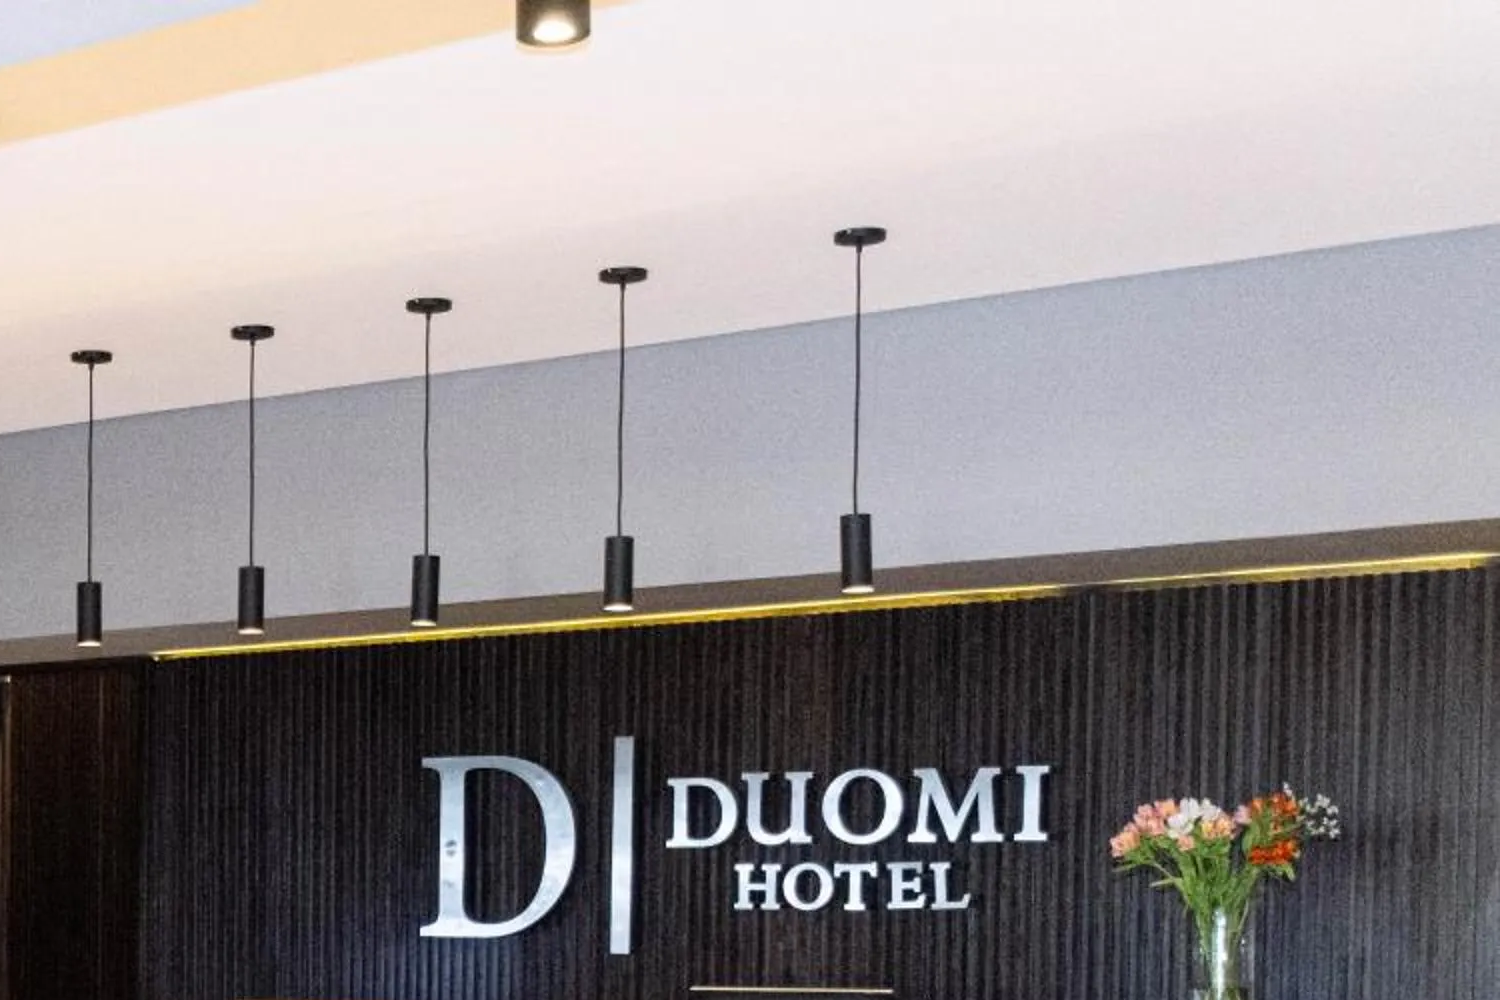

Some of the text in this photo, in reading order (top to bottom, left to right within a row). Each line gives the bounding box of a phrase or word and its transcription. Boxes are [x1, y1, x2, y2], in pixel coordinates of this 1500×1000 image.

[419, 754, 577, 938] D
[665, 764, 1051, 849] DUOMI
[733, 861, 972, 912] HOTEL
